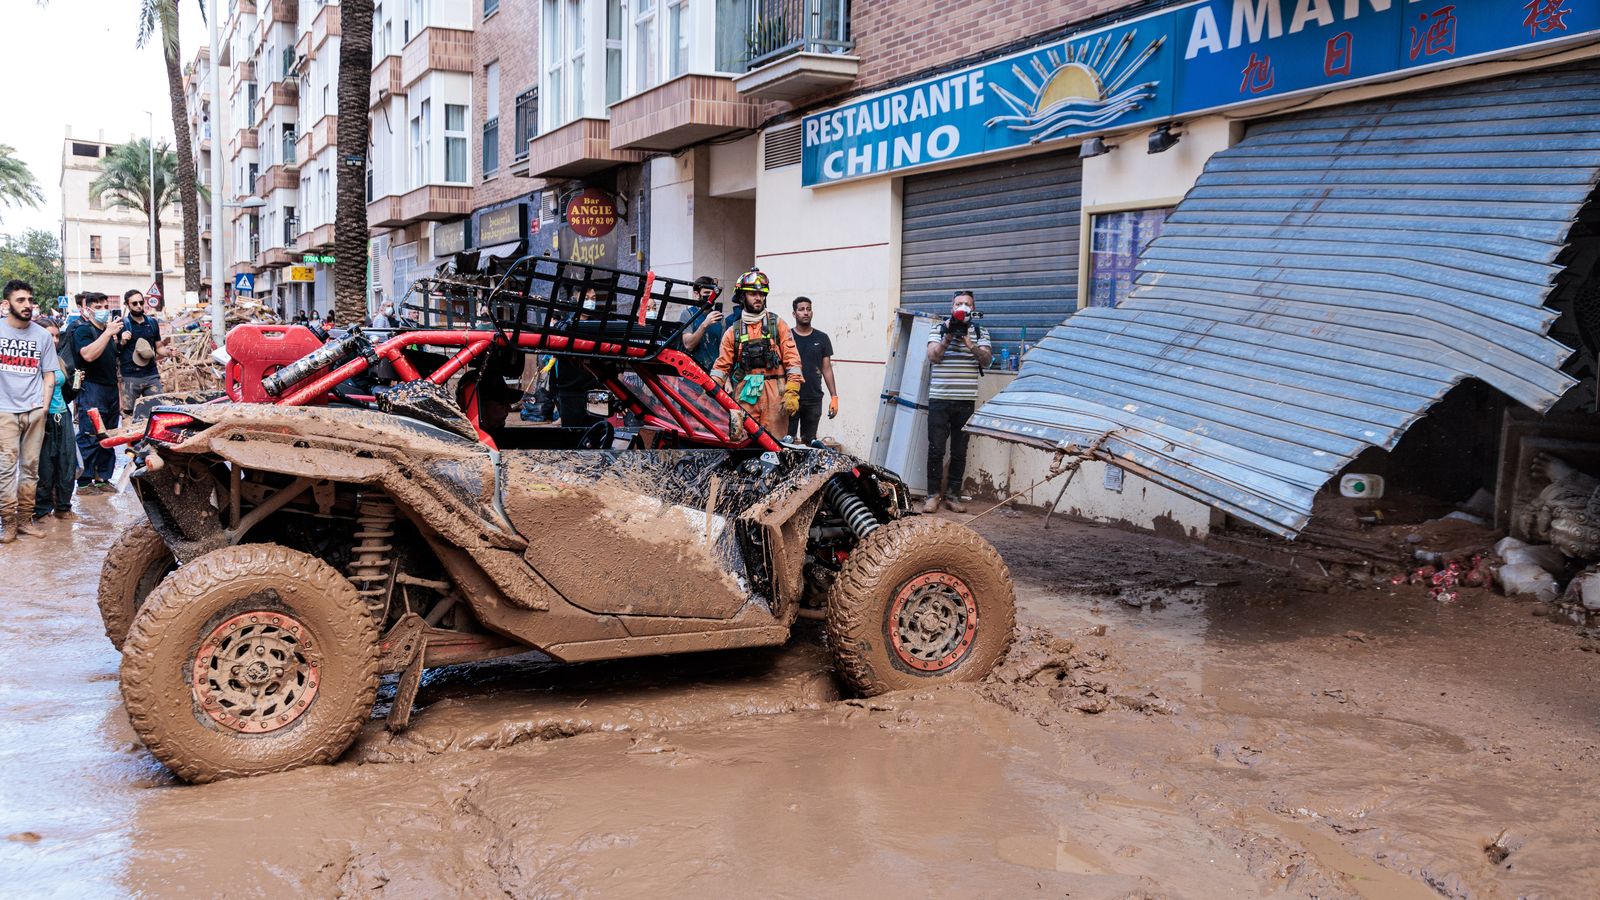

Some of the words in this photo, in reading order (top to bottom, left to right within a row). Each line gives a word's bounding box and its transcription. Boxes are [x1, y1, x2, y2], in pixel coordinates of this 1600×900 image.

[806, 70, 985, 147] RESTAURANTE
[823, 124, 960, 179] CHINO
[571, 205, 612, 215] ANGIE
[571, 217, 580, 226] 96
[582, 217, 594, 225] 147
[595, 217, 604, 225] 82
[605, 217, 614, 225] 09
[570, 237, 606, 265] Angie
[1, 338, 37, 351] BARE
